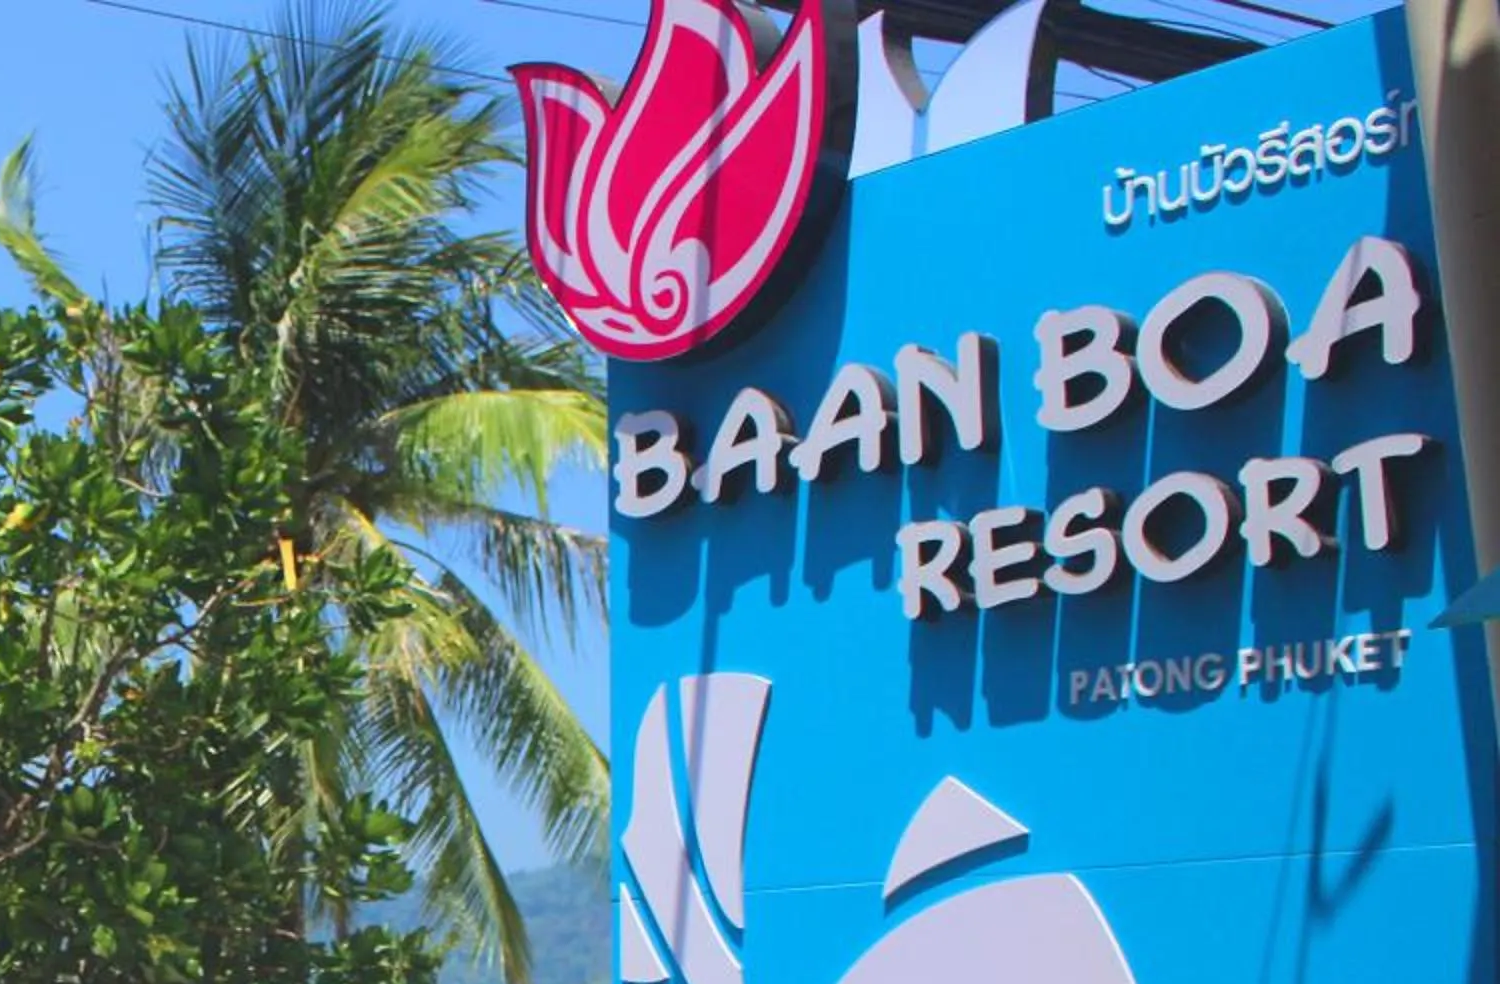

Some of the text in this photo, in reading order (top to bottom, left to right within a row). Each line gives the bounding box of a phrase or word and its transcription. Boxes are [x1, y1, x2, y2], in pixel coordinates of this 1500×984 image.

[613, 236, 1424, 518] BAAN BOA
[897, 432, 1430, 619] RESORT
[1069, 629, 1412, 704] PATONG PHUKET
